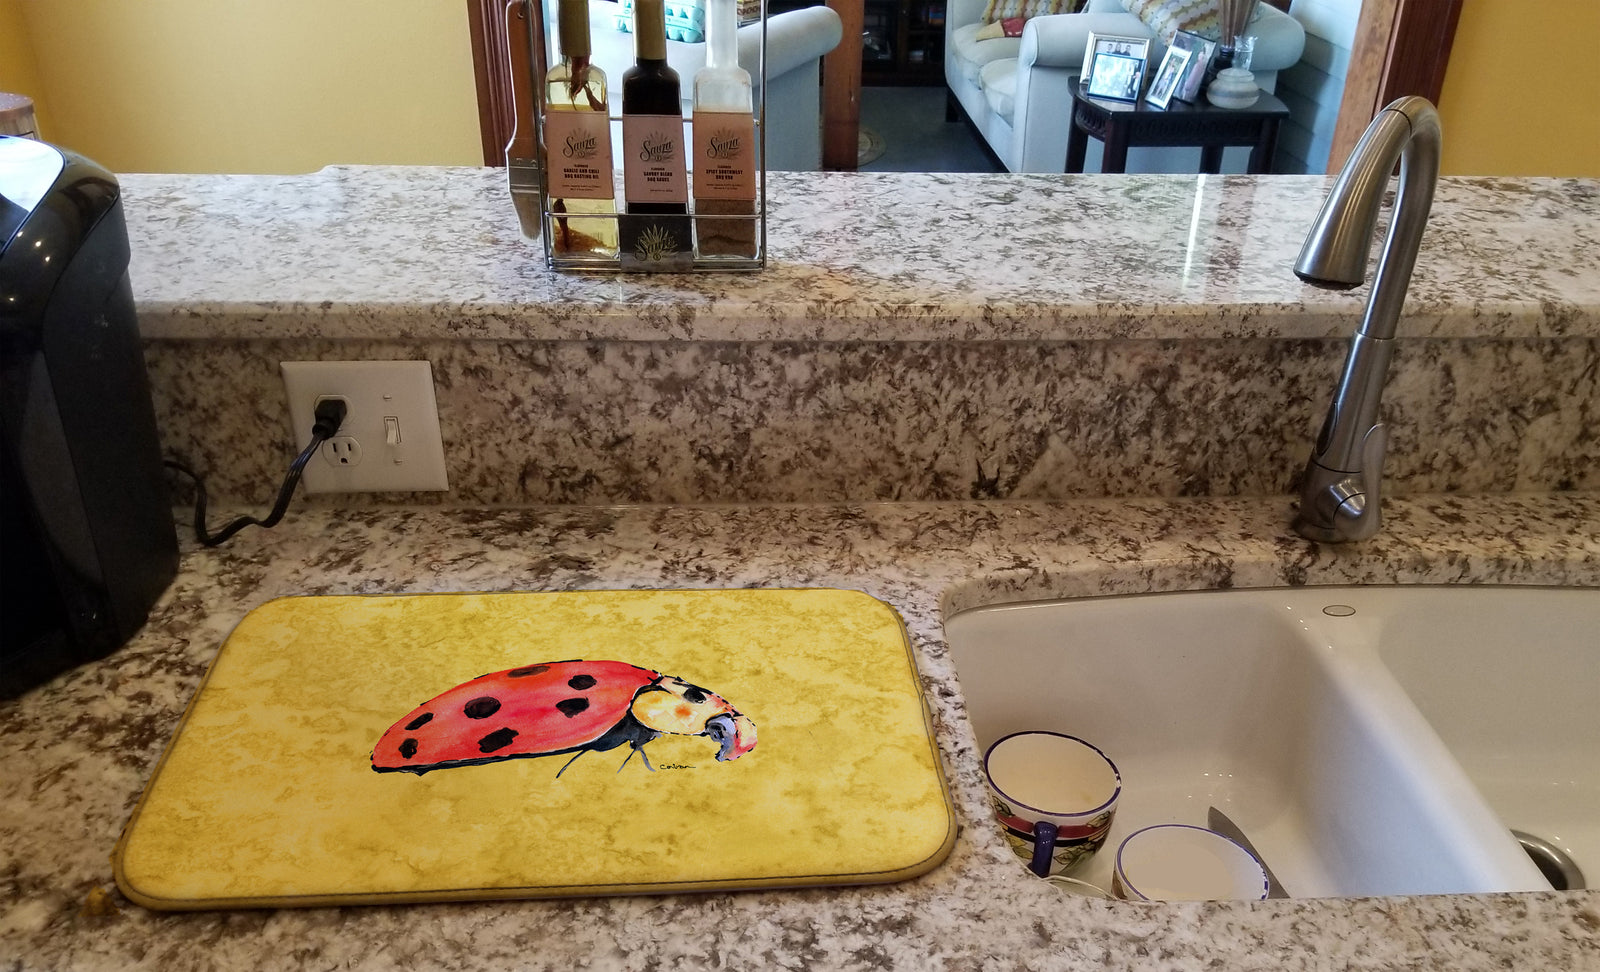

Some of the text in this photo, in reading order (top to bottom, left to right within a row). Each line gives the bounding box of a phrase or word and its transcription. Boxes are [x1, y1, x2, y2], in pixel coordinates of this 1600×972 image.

[563, 136, 597, 158] Sauza
[640, 140, 673, 162] Sauza
[706, 137, 740, 159] Sauza
